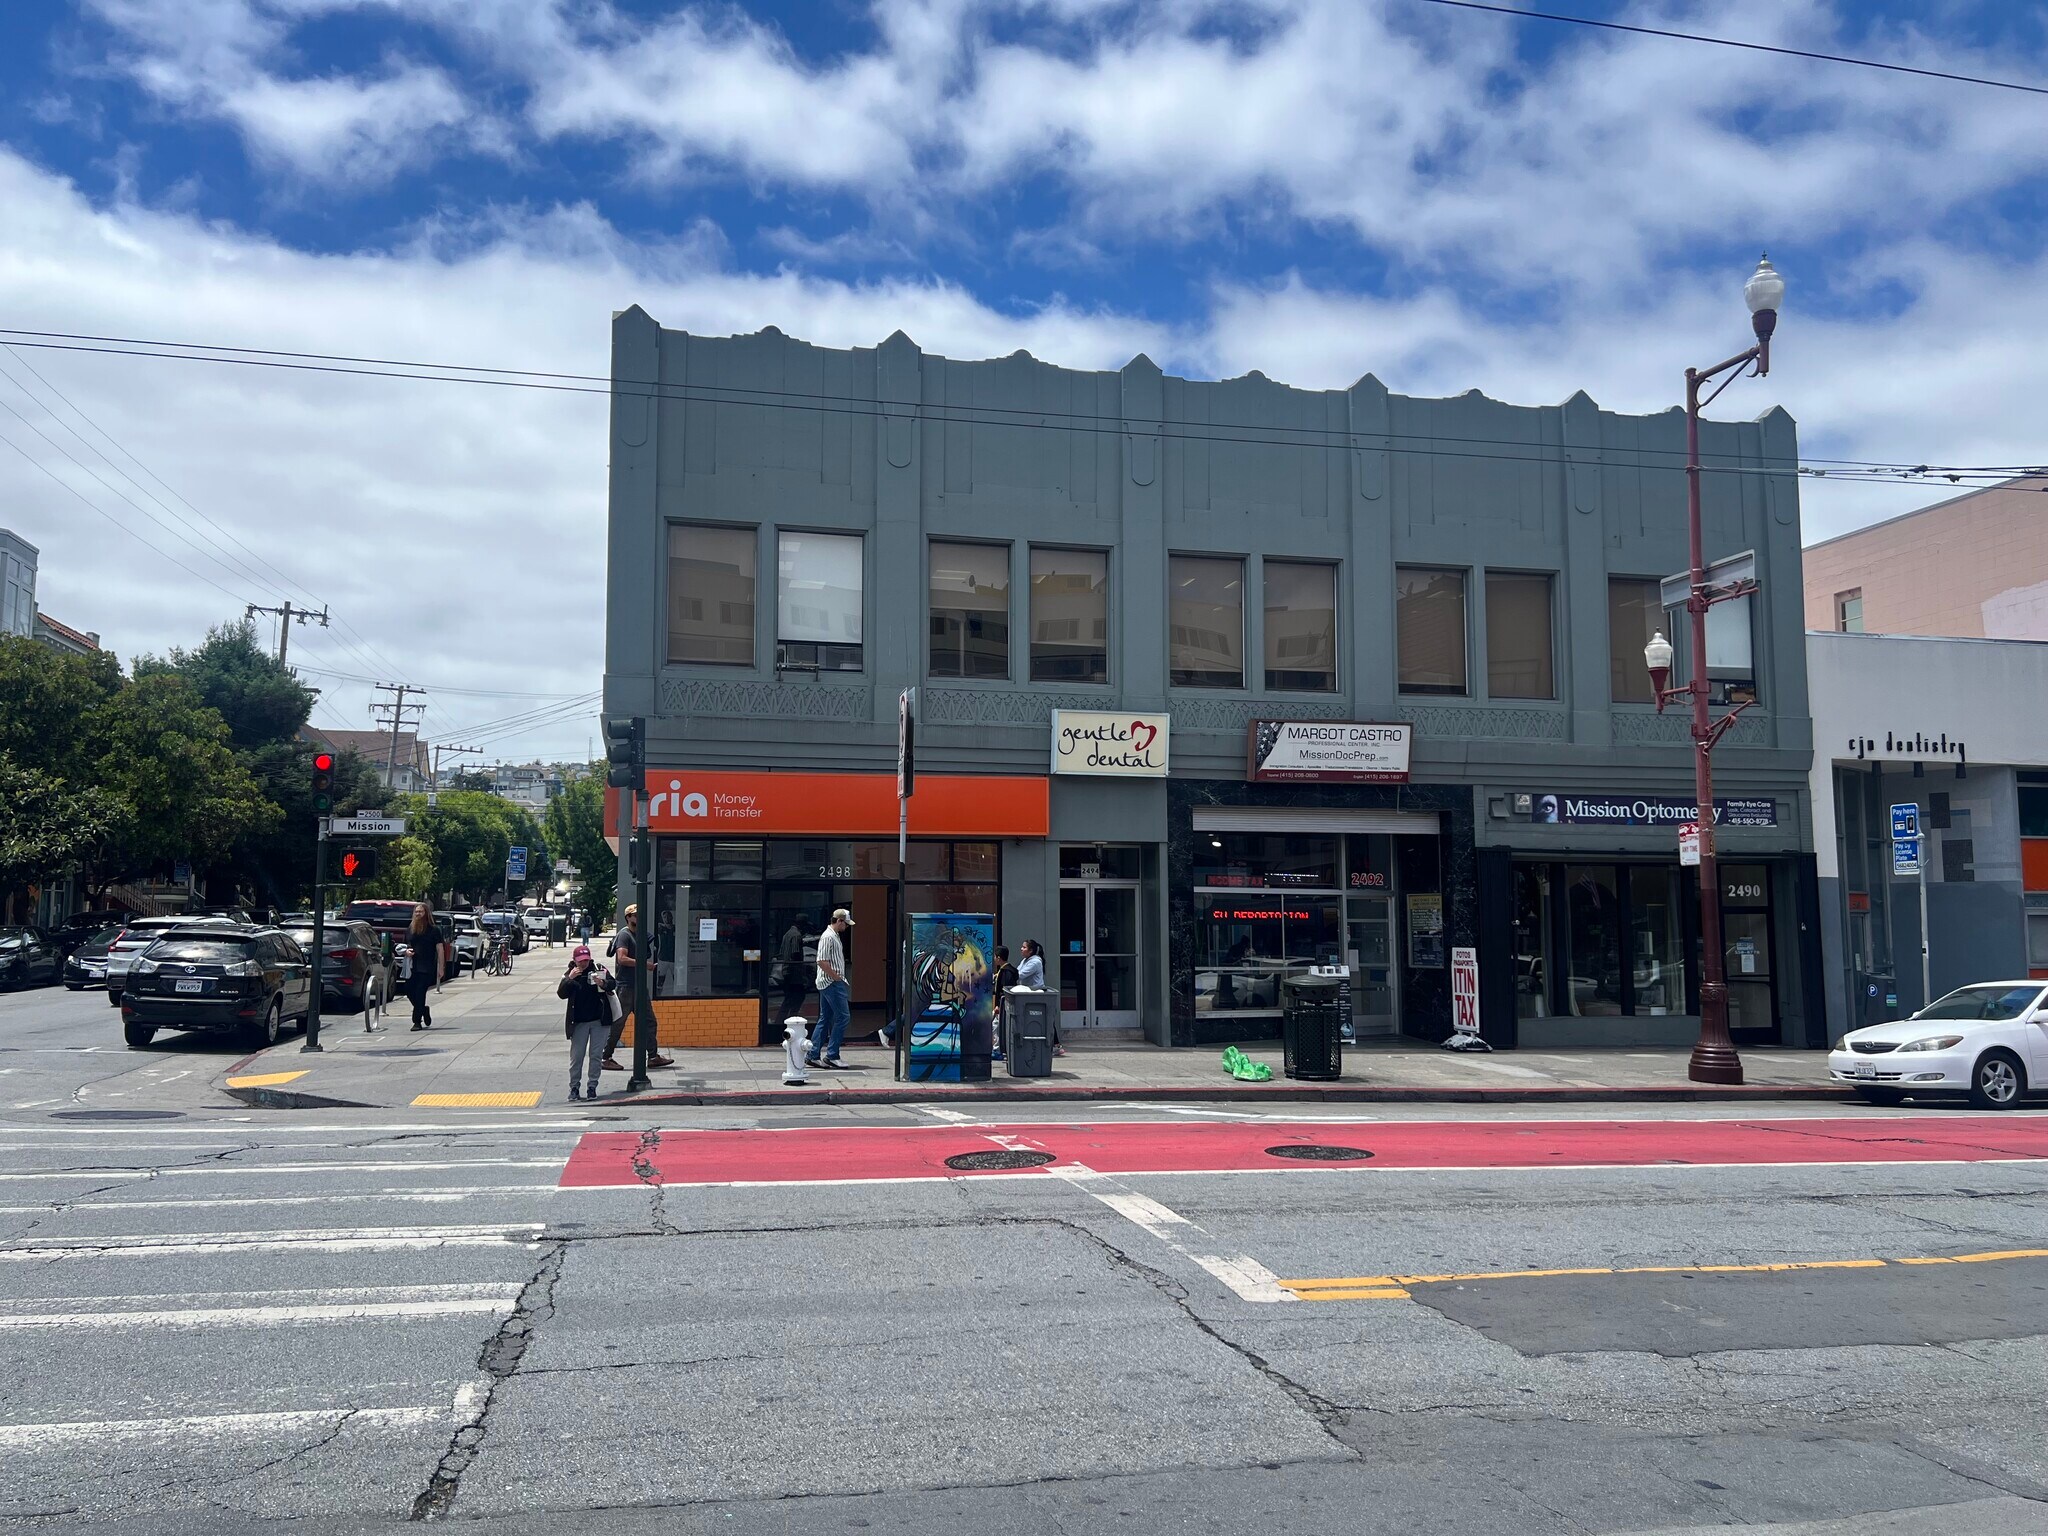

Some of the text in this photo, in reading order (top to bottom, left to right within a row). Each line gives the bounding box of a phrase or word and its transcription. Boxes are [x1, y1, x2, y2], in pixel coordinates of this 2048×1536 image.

[1058, 722, 1133, 755] gentle
[1288, 727, 1402, 742] MARGOT CASTRO
[1086, 740, 1165, 768] dental
[1848, 731, 1966, 763] cjn dentistry
[650, 779, 708, 817] ria
[714, 793, 756, 806] Money
[713, 806, 763, 818] Transfer
[1565, 800, 1723, 824] Mission Optomey
[1892, 807, 1916, 817] Pay here
[347, 821, 391, 831] Mission
[819, 866, 851, 878] 2498
[1351, 873, 1384, 886] 2492
[1728, 885, 1761, 897] 2490
[1456, 951, 1471, 959] FOTOS
[1454, 968, 1475, 994] ITIN
[1454, 994, 1476, 1027] TAX
